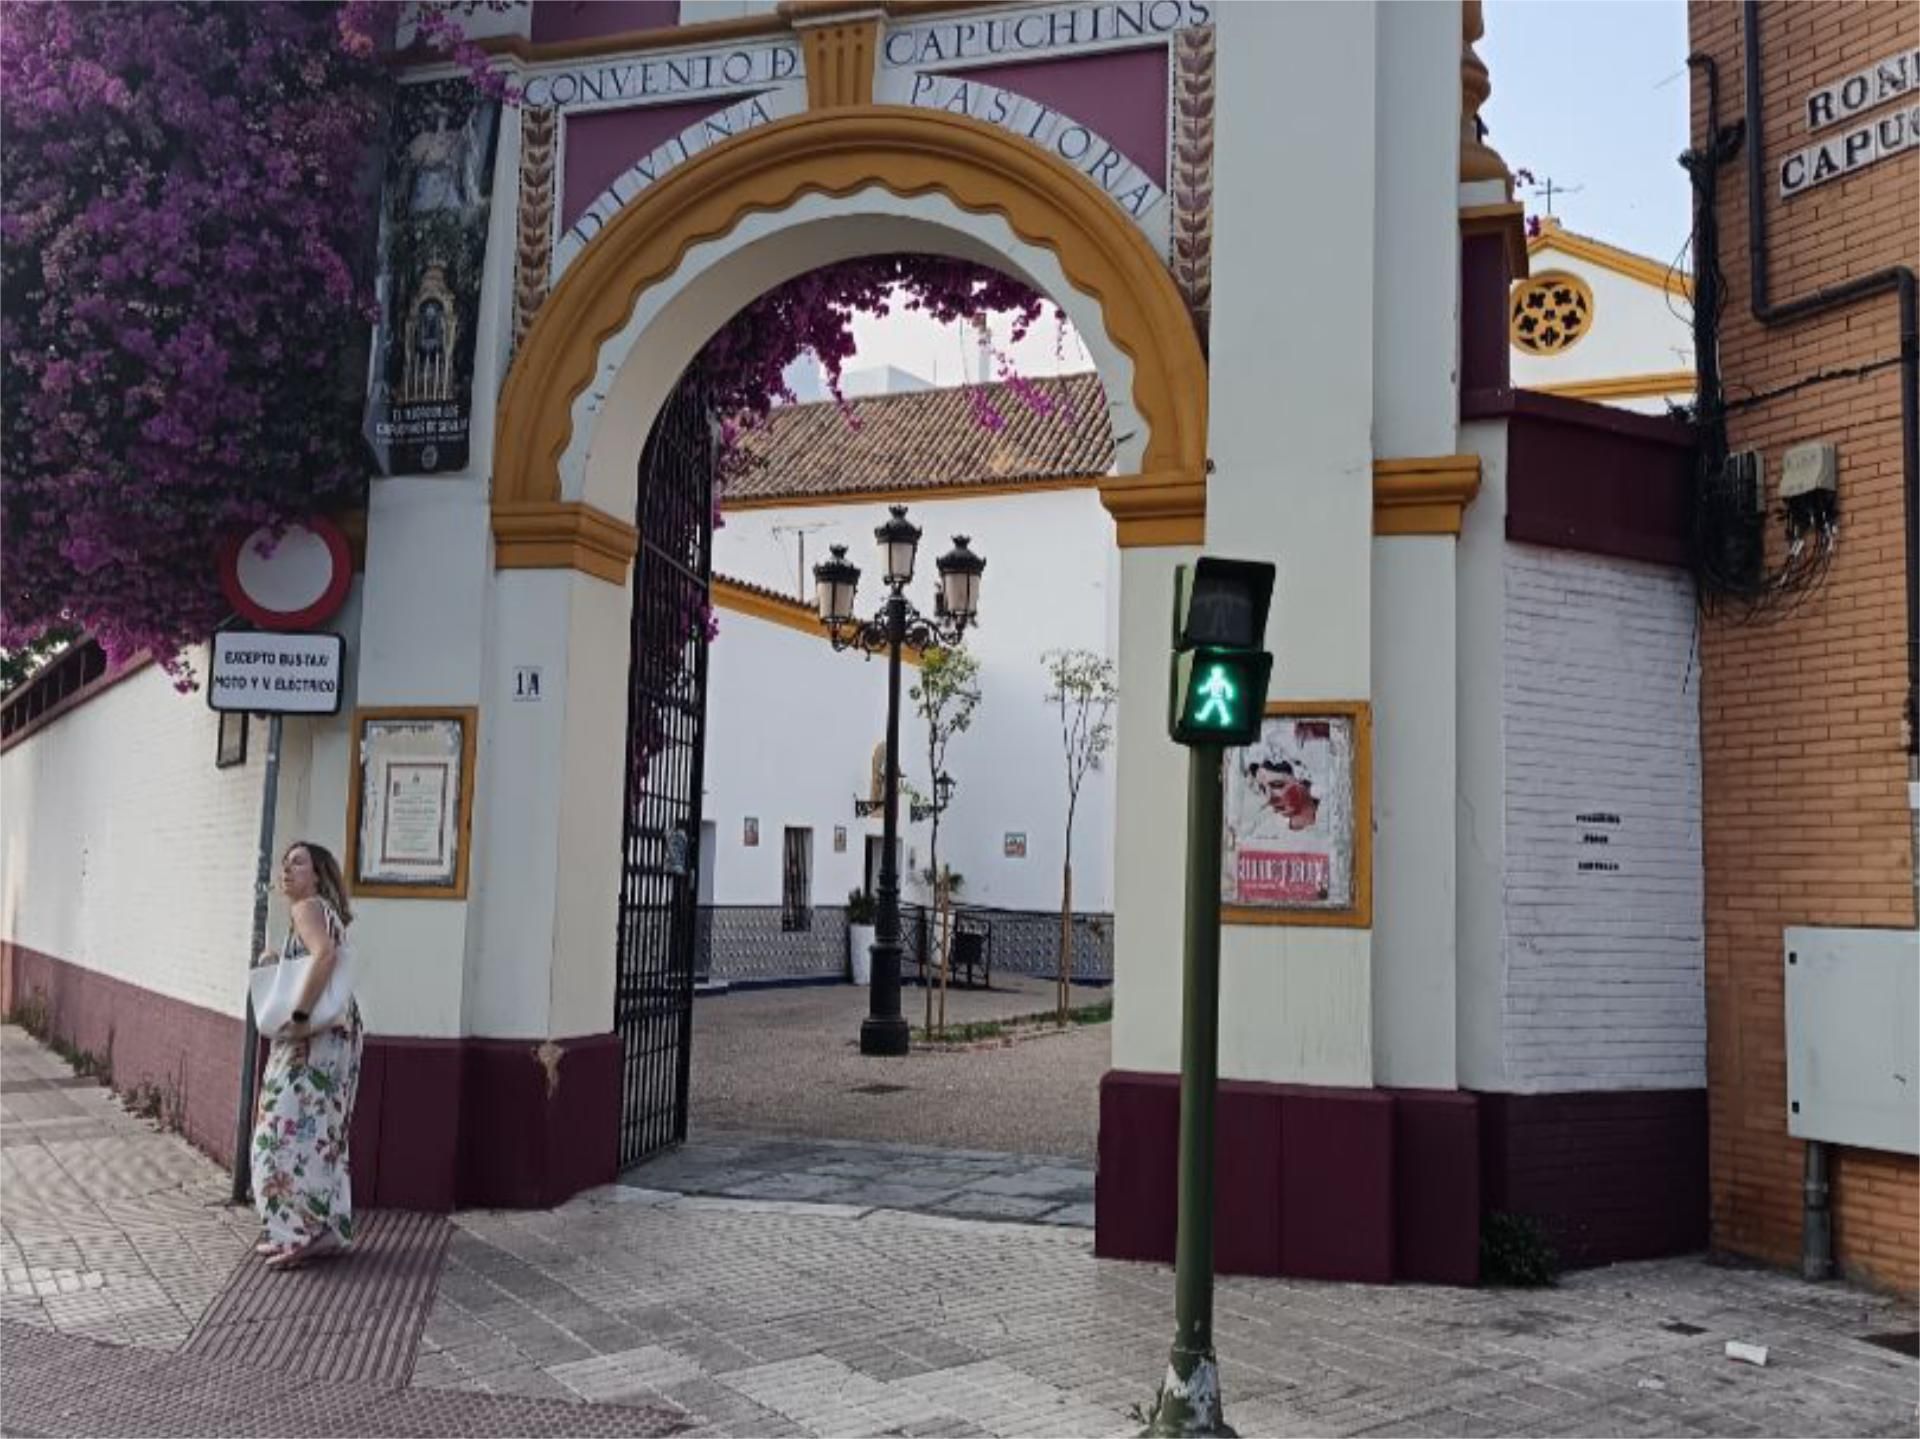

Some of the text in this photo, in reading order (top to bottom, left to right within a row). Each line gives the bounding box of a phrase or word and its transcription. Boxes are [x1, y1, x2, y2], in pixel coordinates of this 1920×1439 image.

[524, 52, 751, 107] CONVENTO
[885, 0, 1210, 65] CAPUCHINOS
[574, 74, 1151, 243] DIVINA PASTORA
[224, 651, 276, 665] EXCEPTO
[215, 675, 247, 689] MOTO
[251, 677, 259, 689] Y
[516, 670, 539, 696] 1A
